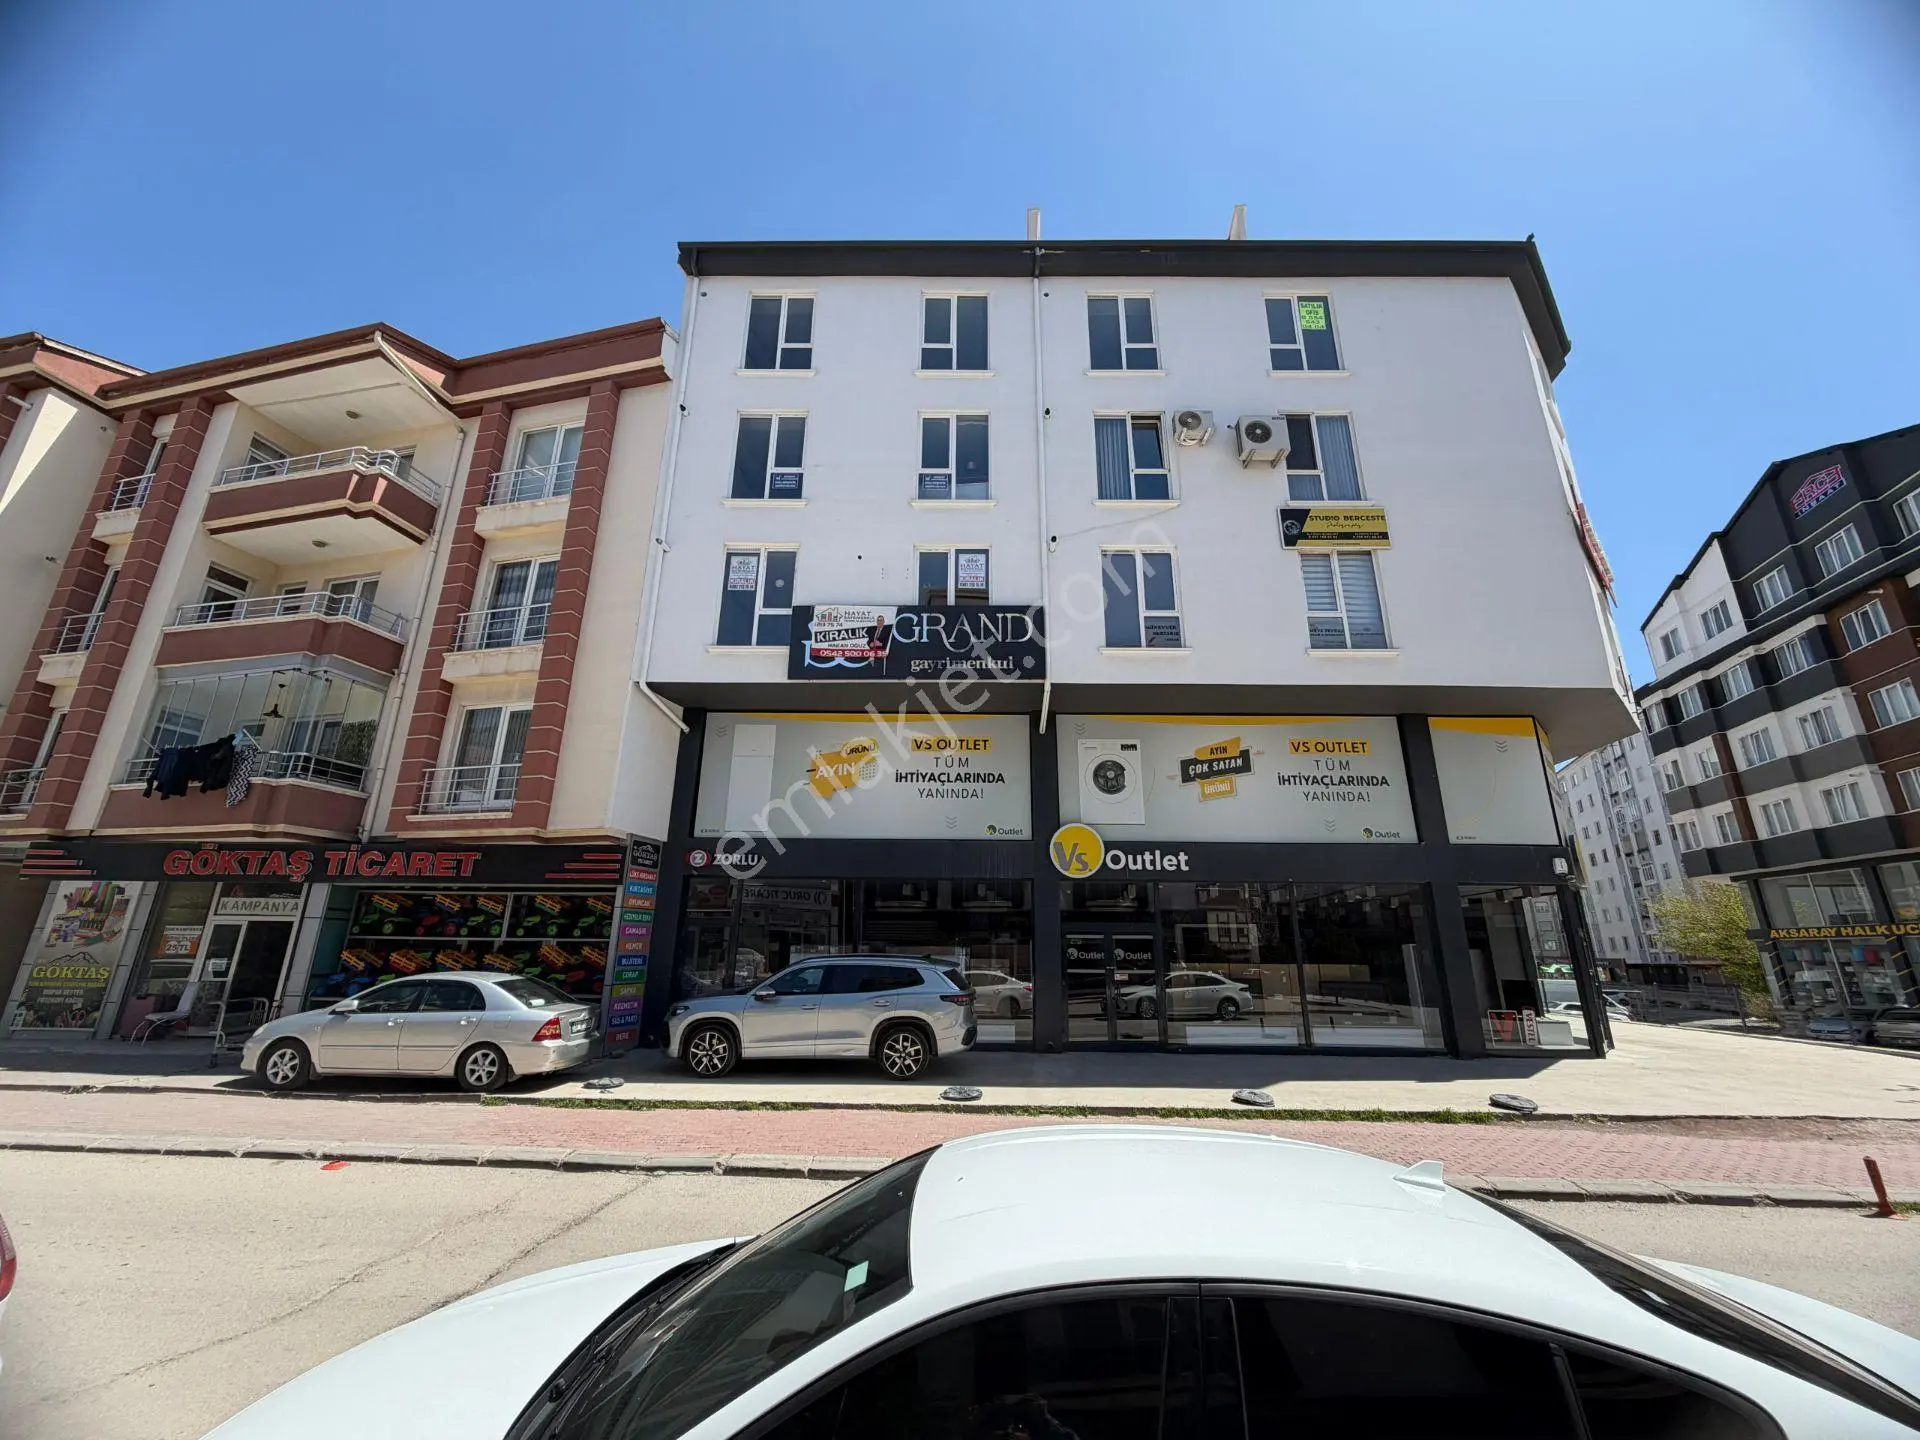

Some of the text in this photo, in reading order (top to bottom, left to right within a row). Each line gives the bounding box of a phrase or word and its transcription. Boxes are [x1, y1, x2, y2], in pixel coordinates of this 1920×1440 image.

[816, 628, 868, 642] KİRALIK
[892, 612, 1033, 653] GRAND
[914, 739, 989, 750] VS OUTLET
[1210, 746, 1228, 756] AYIN
[1290, 742, 1367, 753] VS OUTLET
[933, 754, 969, 768] TÜM
[1188, 757, 1243, 777] ÇOK SATAN
[1313, 757, 1351, 772] TÜM
[815, 762, 856, 780] AYIN
[895, 769, 1006, 786] İHTİYAÇLARINDA
[1204, 780, 1231, 794] ÜRÜNÜ
[1277, 772, 1390, 789] İHTİYAÇLARINDA
[918, 788, 984, 799] YANINDA!
[1302, 791, 1371, 802] YANINDA!
[998, 827, 1024, 836] Outlet
[163, 842, 483, 882] GÖKTAŞ TİCARET
[712, 854, 758, 866] ZORLU
[1105, 849, 1190, 871] Outlet
[220, 901, 300, 912] KAMPANYA
[1770, 922, 1920, 939] AKSARAY HALK UC
[1078, 952, 1105, 960] Outlet
[1125, 952, 1152, 960] Outlet
[32, 963, 110, 982] GÖKTAŞ
[1526, 1013, 1536, 1042] VESTEL
